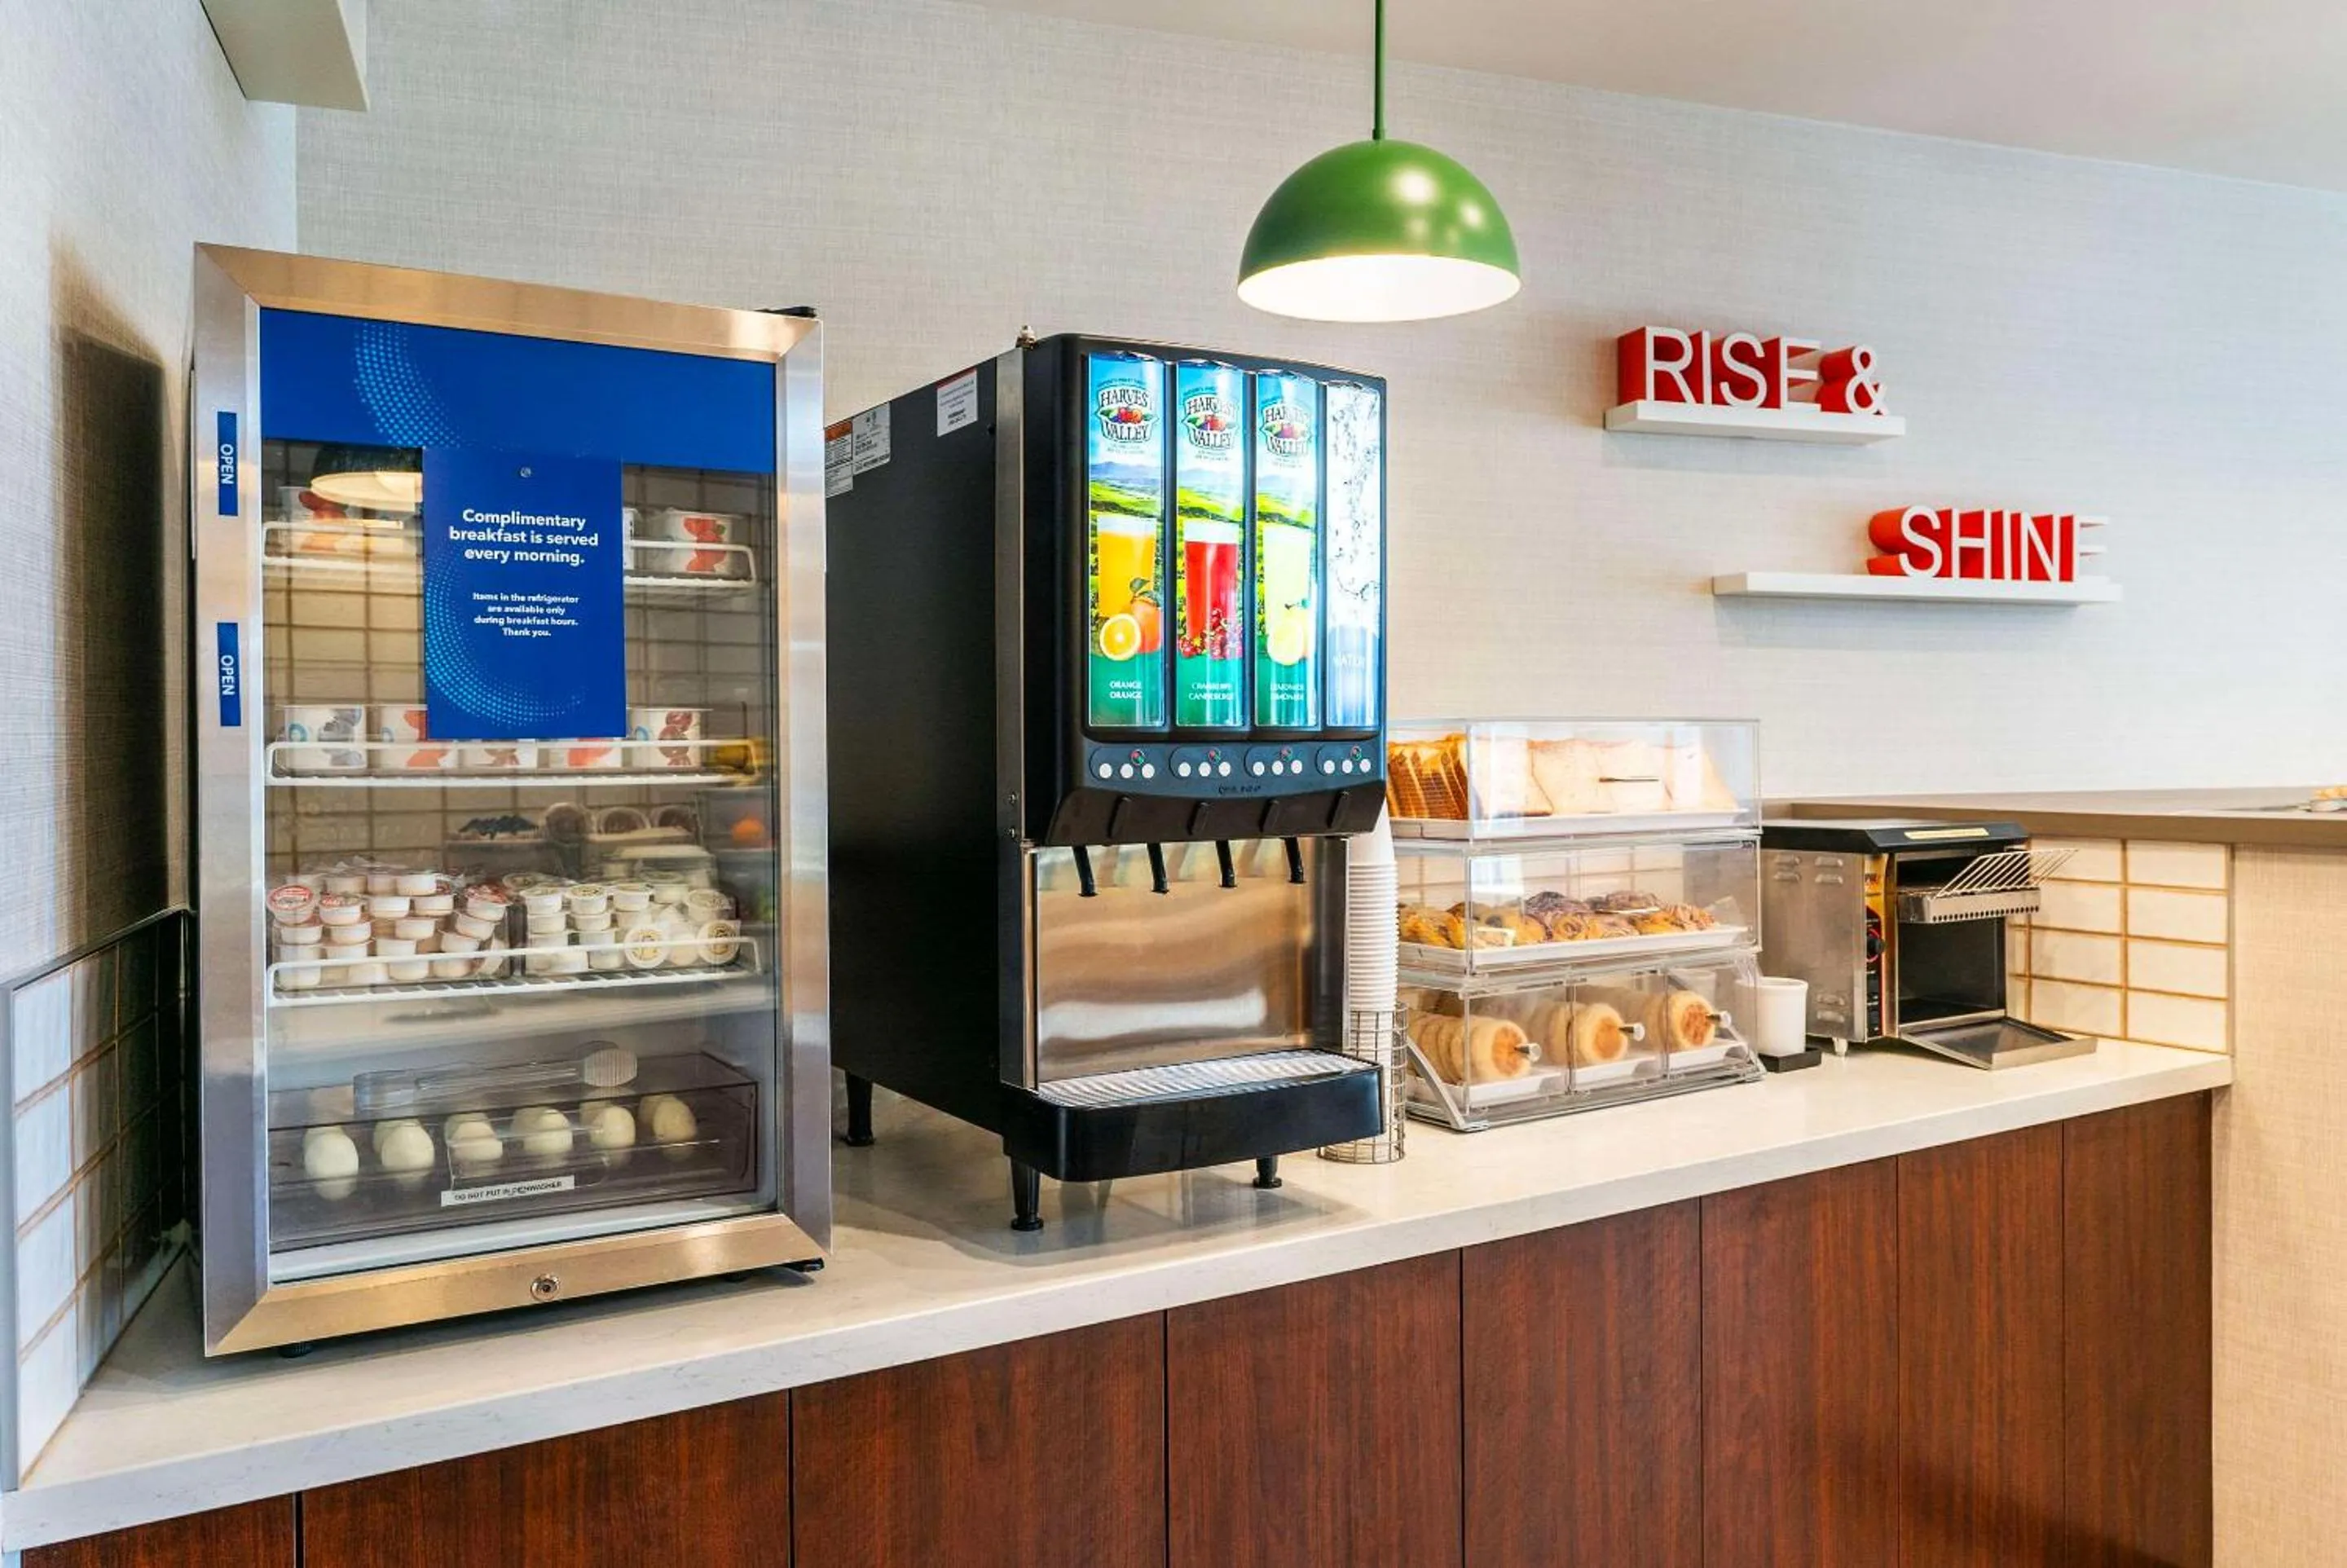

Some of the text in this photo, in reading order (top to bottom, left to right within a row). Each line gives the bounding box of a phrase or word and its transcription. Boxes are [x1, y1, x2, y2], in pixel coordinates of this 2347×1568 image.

[1642, 326, 1889, 416] RISE &
[1104, 420, 1150, 441] VALLEY
[220, 443, 234, 486] OPEN
[462, 509, 586, 531] Complimentary
[449, 526, 598, 546] breakfast is served
[1898, 504, 2111, 584] SHINE
[464, 548, 585, 567] every morning.
[473, 592, 579, 605] Items in the refrigerator
[504, 605, 544, 614] available
[545, 606, 566, 615] only
[473, 615, 579, 626] during breakfast hours.
[502, 627, 552, 637] Thank you.
[220, 654, 234, 696] OPEN
[486, 1188, 500, 1197] PUT
